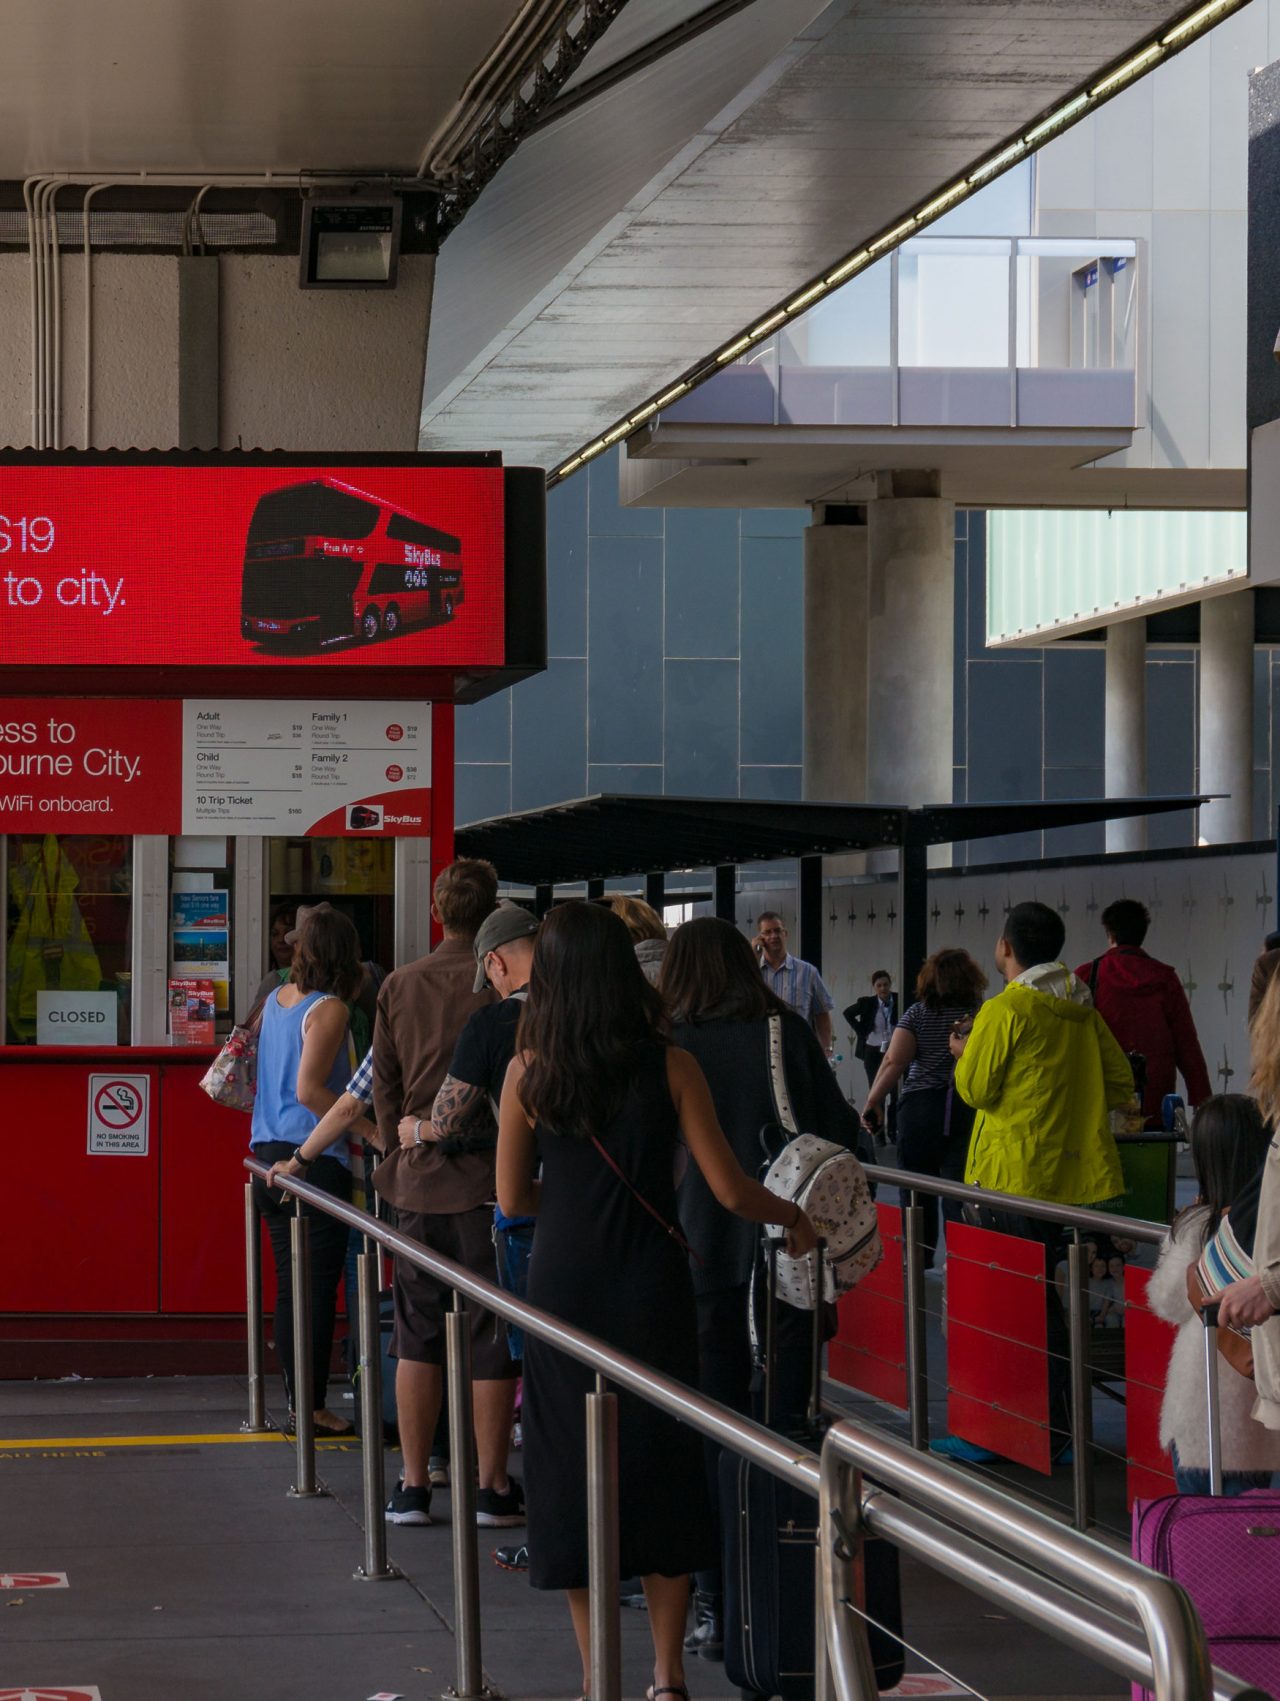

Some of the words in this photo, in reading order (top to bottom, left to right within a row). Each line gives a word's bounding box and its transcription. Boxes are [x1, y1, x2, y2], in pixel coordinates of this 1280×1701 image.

[4, 571, 43, 605] to
[56, 568, 126, 615] city.
[197, 712, 221, 720] Adult
[312, 712, 340, 723] Family
[343, 713, 347, 721] 1
[47, 718, 76, 743] to
[196, 752, 220, 761] Child
[311, 753, 340, 764] Family
[342, 754, 348, 762] 2
[83, 748, 141, 782] City.
[38, 796, 114, 812] onboard.
[196, 796, 207, 804] 10
[208, 796, 225, 805] Trip
[228, 796, 253, 805] Ticket
[383, 815, 422, 825] SkyBus
[48, 1011, 106, 1023] CLOSED
[42, 1450, 106, 1458] HERE
